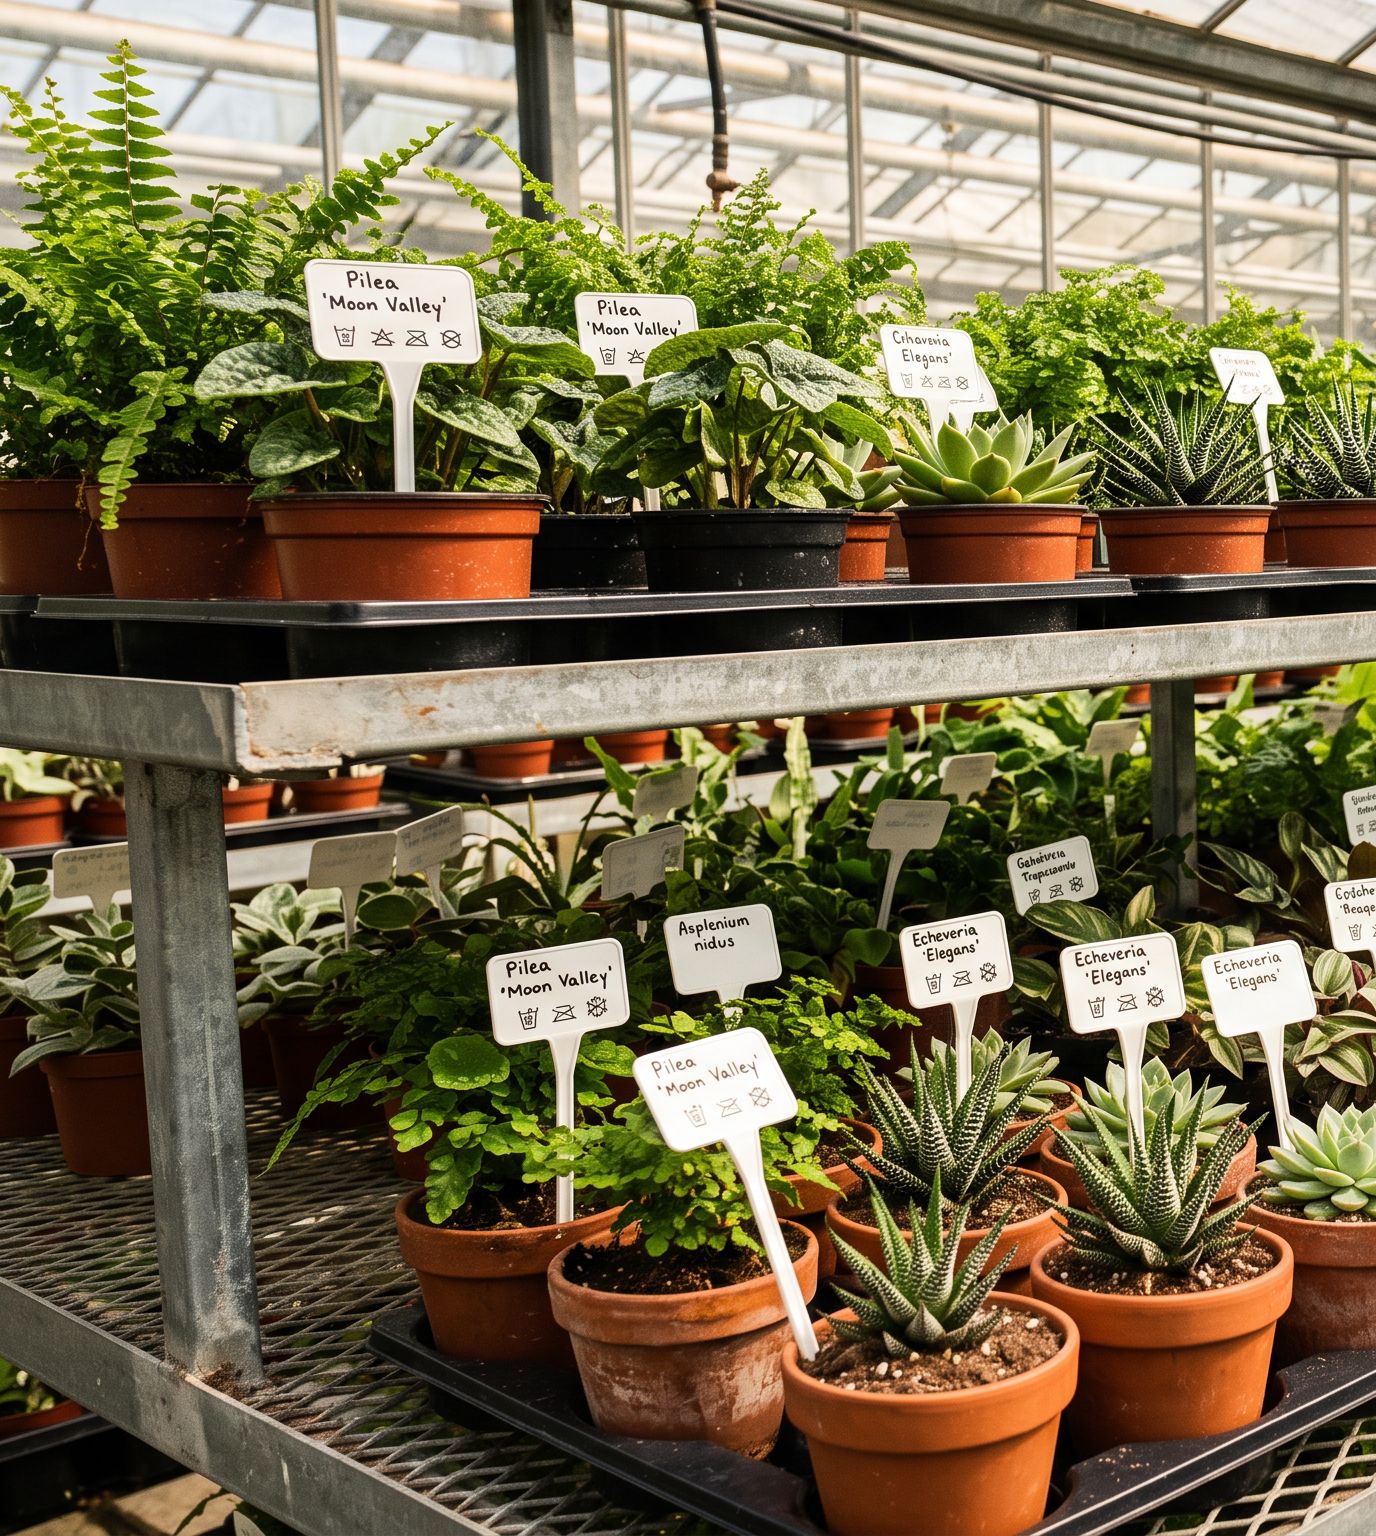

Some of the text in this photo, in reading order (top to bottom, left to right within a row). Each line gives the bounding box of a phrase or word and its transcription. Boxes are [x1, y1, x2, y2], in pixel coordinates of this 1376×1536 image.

[346, 270, 399, 290] Pilea
[323, 293, 447, 322] 'Moon Valley'
[597, 300, 641, 316] Pilea
[587, 321, 629, 335] 'Moon
[679, 916, 750, 938] Asplenium
[912, 924, 978, 947] Echeveria
[694, 936, 735, 951] nidus
[922, 939, 979, 963] 'Elegans'
[1074, 944, 1147, 967] Echeveria
[1214, 952, 1282, 975] Echeveria
[506, 960, 551, 978] Pilea
[1085, 960, 1150, 986] 'Elegans'
[1225, 968, 1280, 991] 'Elegans'
[501, 965, 612, 998] 'Moon Valley'
[651, 1058, 696, 1079] Pilea
[657, 1054, 759, 1096] 'Moon Valley'
